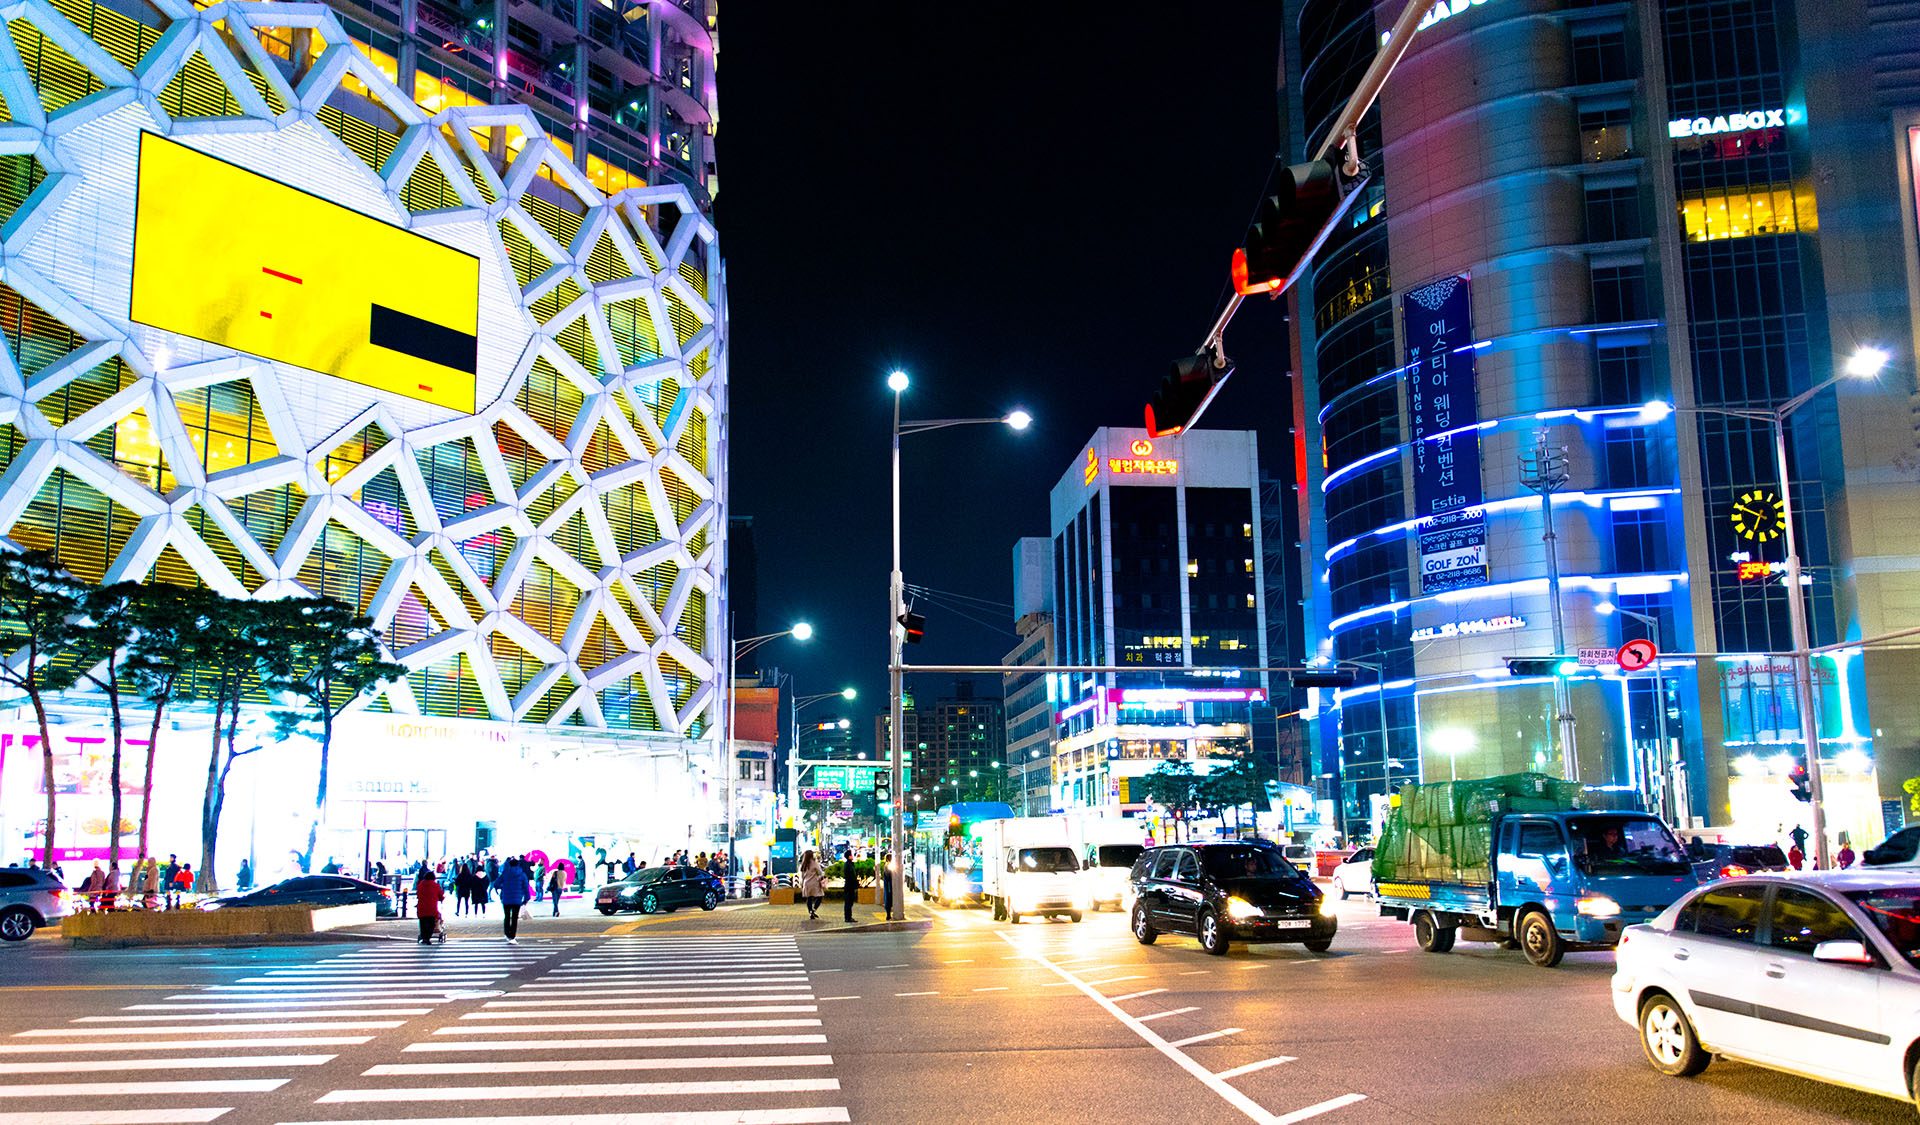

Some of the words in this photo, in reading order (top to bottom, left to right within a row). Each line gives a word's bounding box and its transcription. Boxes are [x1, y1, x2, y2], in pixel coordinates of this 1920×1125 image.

[1429, 319, 1448, 386] 에스티아
[1411, 346, 1422, 411] WEDDING
[1415, 415, 1423, 424] &
[1434, 393, 1450, 428] 웨딩
[1416, 428, 1426, 473] PARTY
[1108, 459, 1177, 474] 웰컴저축은행
[1437, 433, 1454, 487] 컨벤션
[1432, 494, 1466, 511] Estia
[1427, 541, 1447, 552] 스크린
[1468, 537, 1479, 545] B3
[1426, 558, 1452, 572] GOLF
[1456, 552, 1480, 567] ZON
[1126, 652, 1143, 663] 치과
[1155, 652, 1182, 663] 턱관절
[1580, 650, 1615, 659] 좌회전금지
